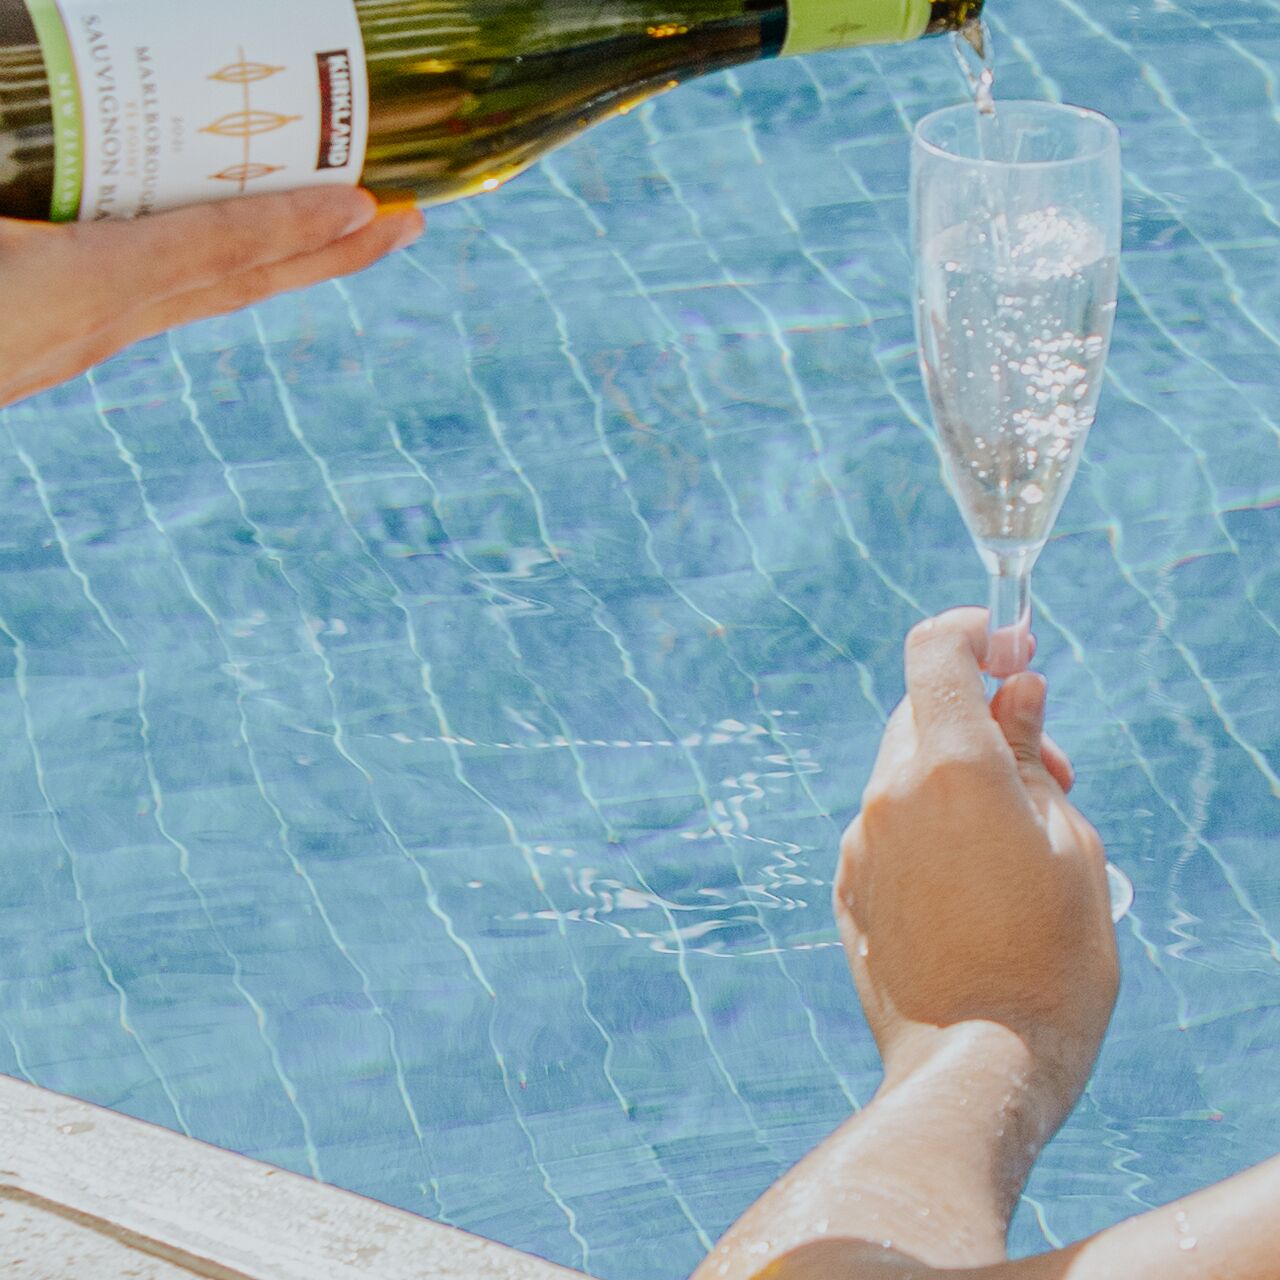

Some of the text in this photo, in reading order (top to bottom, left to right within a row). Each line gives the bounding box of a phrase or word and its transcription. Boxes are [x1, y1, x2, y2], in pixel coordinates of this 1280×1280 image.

[60, 72, 76, 118] NEW
[83, 15, 121, 176] SAUVIGNON
[328, 54, 352, 166] KIRKLAND
